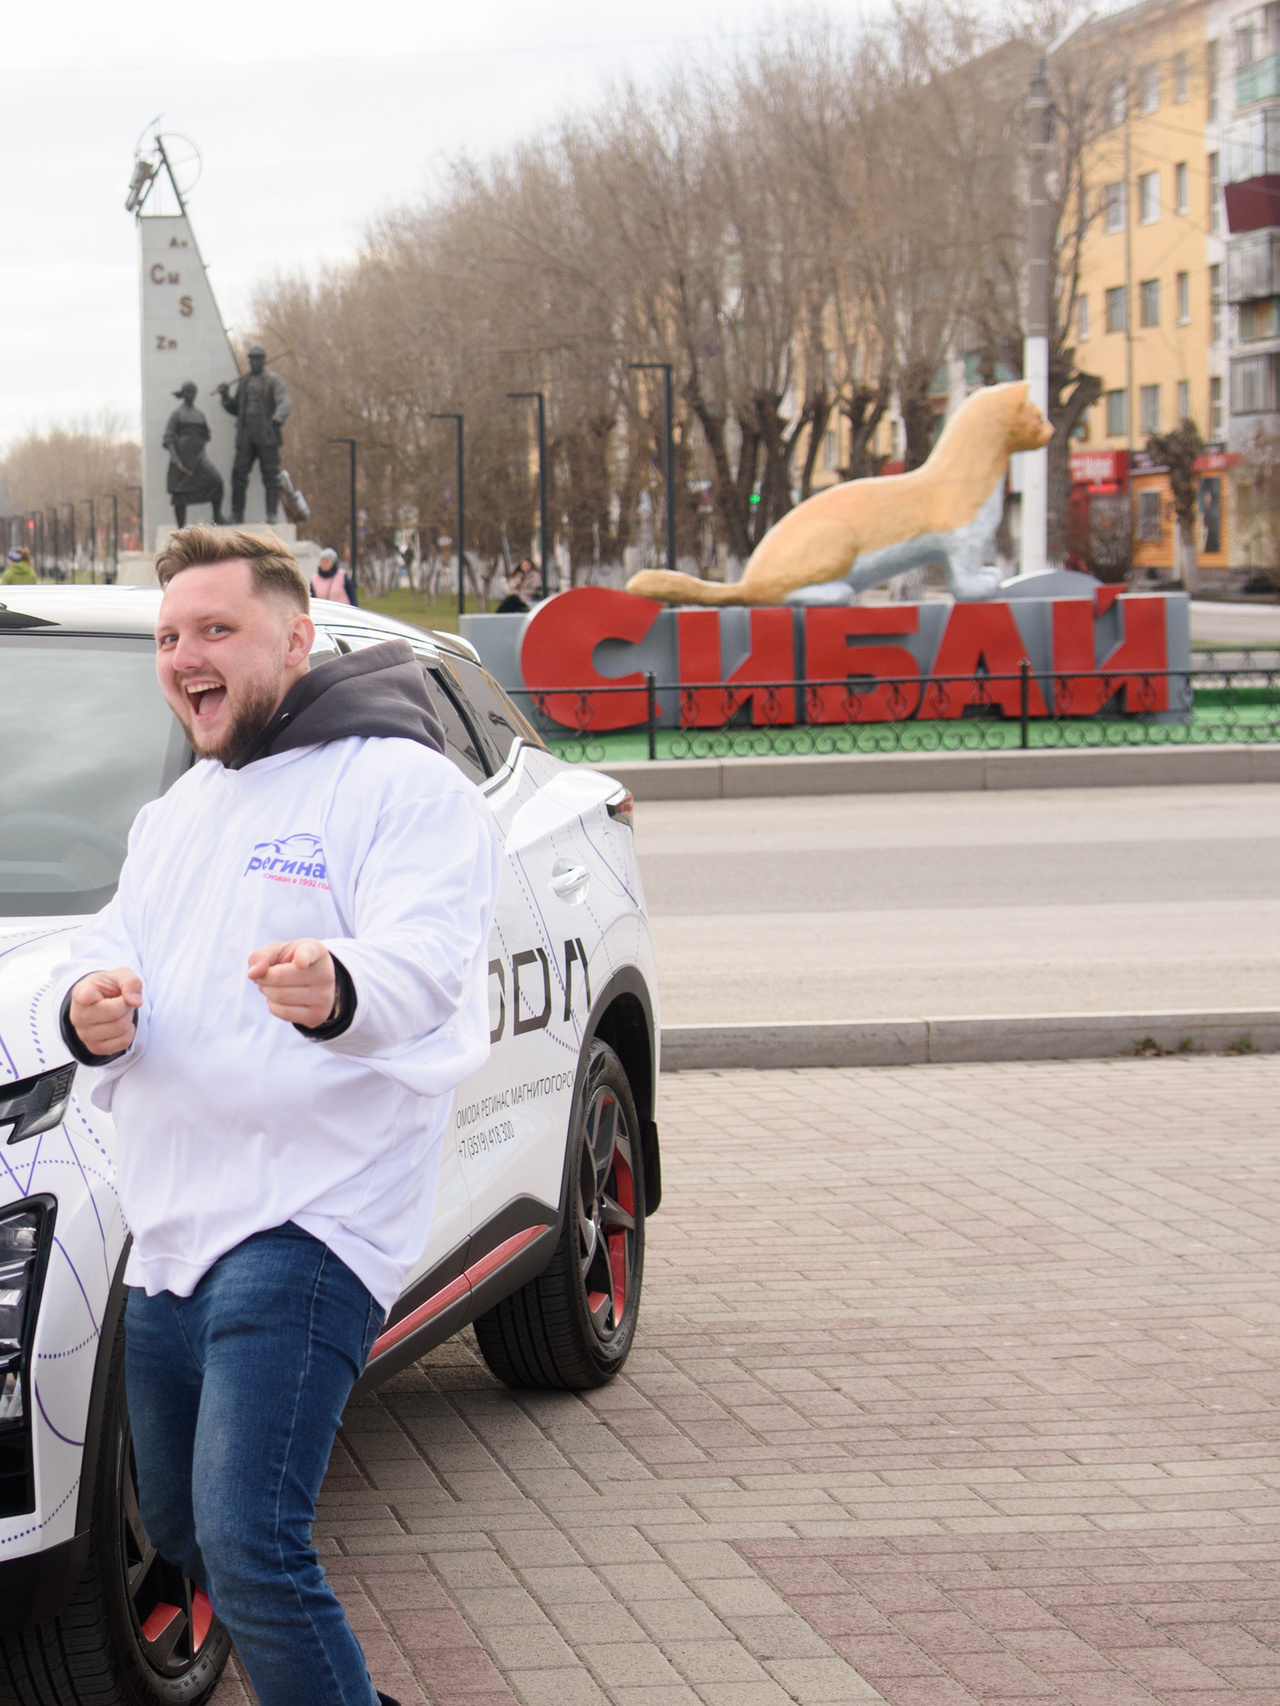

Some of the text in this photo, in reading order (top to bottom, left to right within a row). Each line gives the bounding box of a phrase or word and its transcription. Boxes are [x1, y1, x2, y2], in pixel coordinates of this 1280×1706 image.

[149, 263, 181, 285] Cu
[179, 295, 193, 317] S
[156, 335, 178, 350] Zn
[519, 584, 1169, 731] СИБАЙ
[299, 877, 317, 888] 1992
[456, 1101, 480, 1129] OMODA
[481, 1089, 510, 1118] РЕГИНАС
[488, 1126, 502, 1147] 418
[500, 1120, 515, 1142] 300
